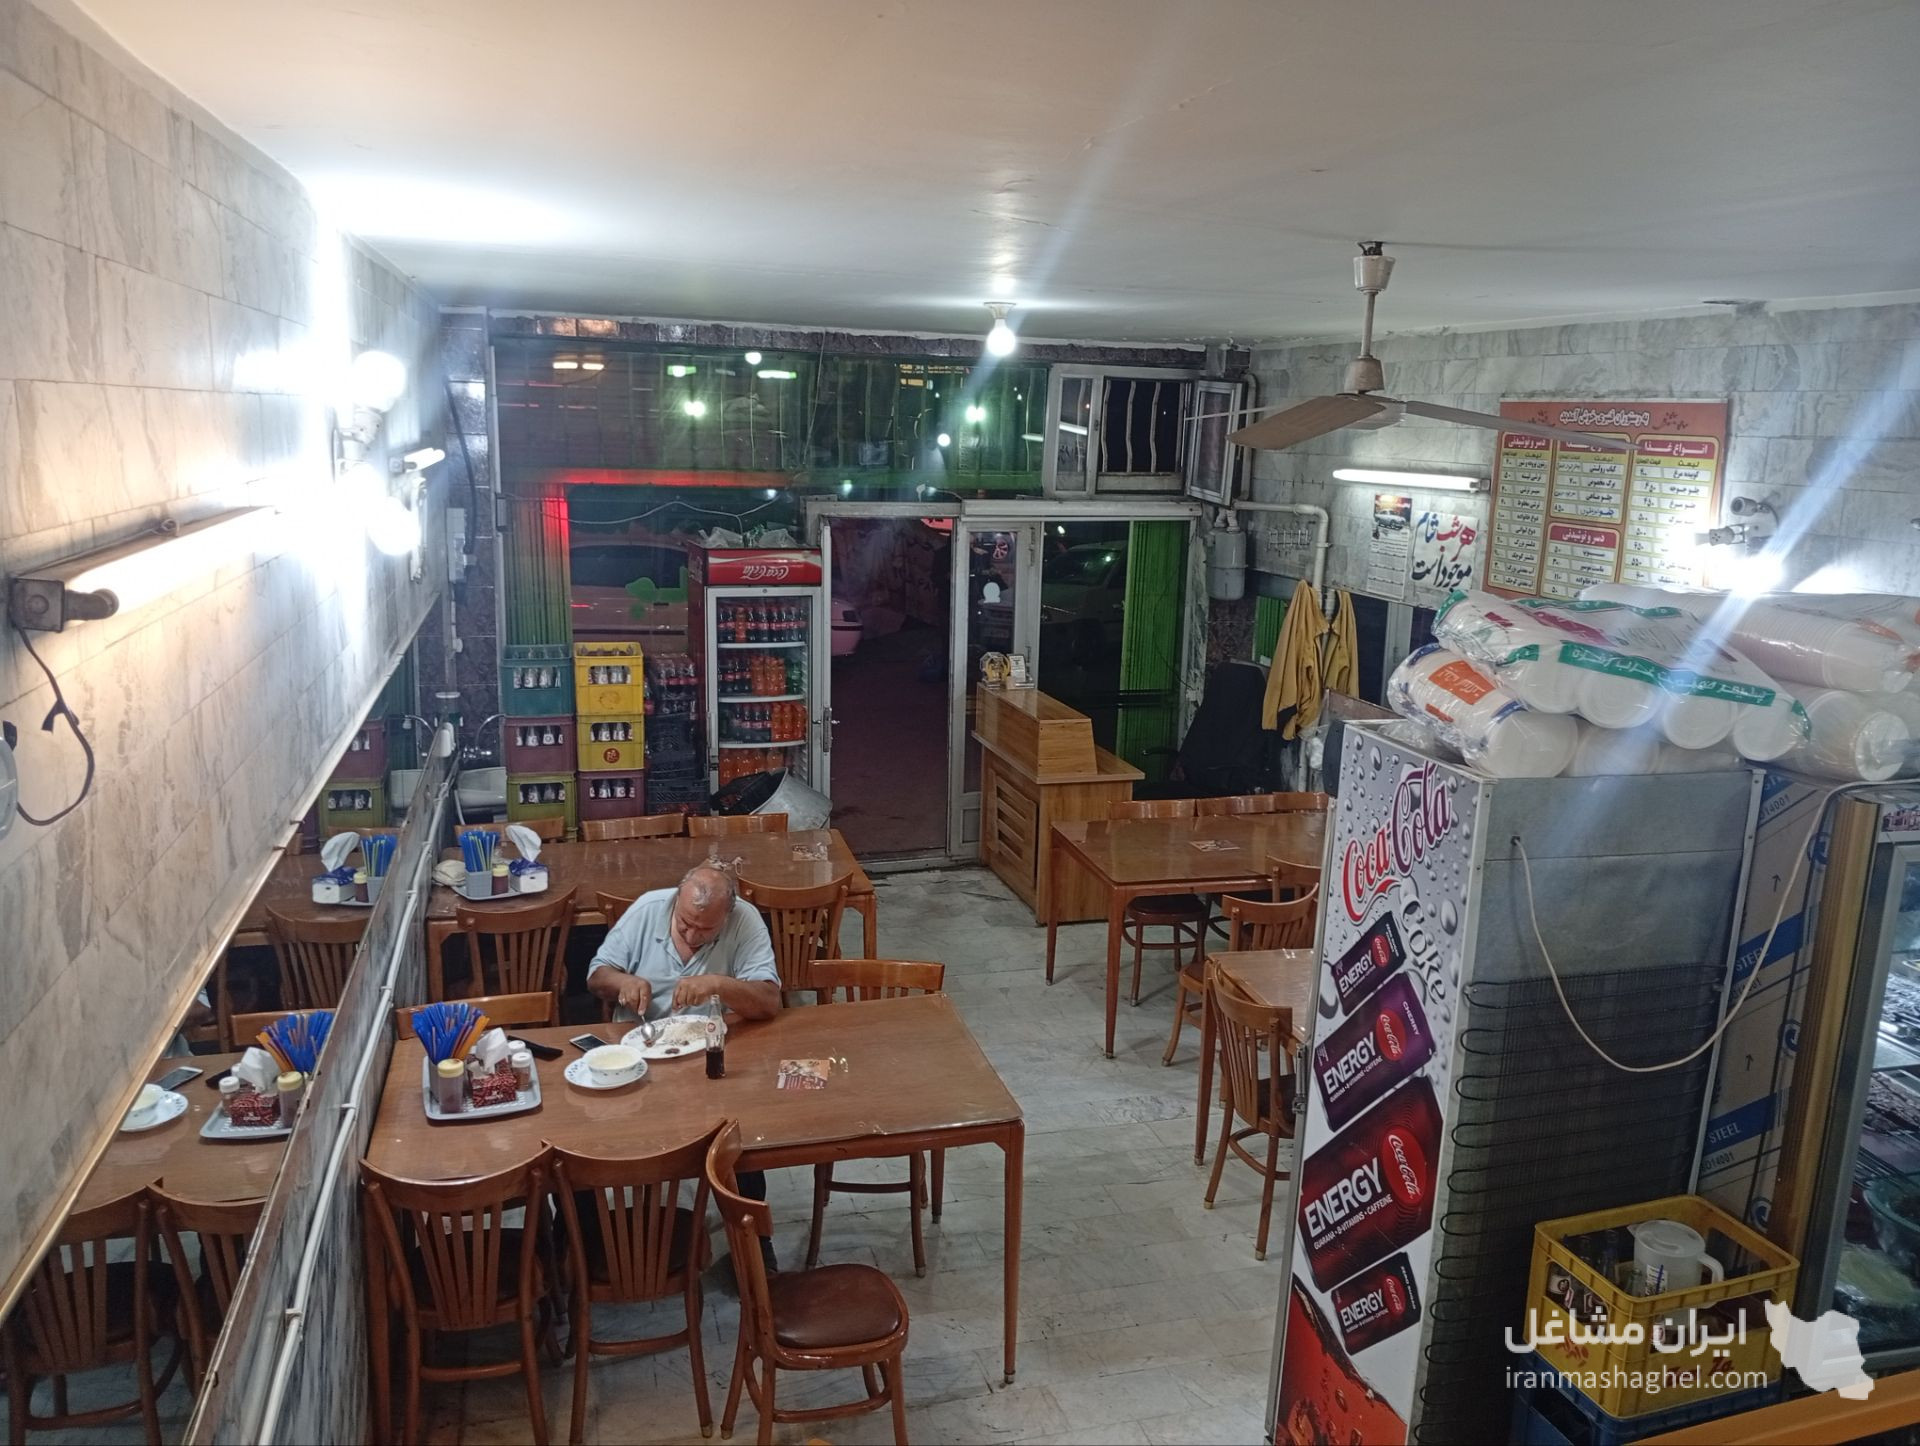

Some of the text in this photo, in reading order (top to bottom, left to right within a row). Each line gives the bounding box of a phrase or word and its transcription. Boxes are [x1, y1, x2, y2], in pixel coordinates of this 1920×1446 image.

[1508, 435, 1531, 448] نوشیدنی
[1644, 441, 1708, 456] انواع غذا
[1416, 512, 1477, 562] هر شب شام
[1562, 528, 1587, 543] نوشیدنی
[1592, 534, 1606, 545] دسر
[1411, 554, 1444, 585] است
[1440, 563, 1472, 593] موجود
[1341, 759, 1453, 925] Coca-Cola
[1400, 893, 1449, 1006] Coke
[1339, 949, 1375, 993] ENERGY
[1402, 1001, 1420, 1036] CHERRY
[1322, 1031, 1377, 1095] ENERGY
[1708, 1122, 1742, 1145] STEEL
[1388, 1133, 1421, 1200] Coca-Cola
[1304, 1157, 1384, 1238] ENERGY
[1367, 1196, 1393, 1214] CAFFEINE
[1341, 1288, 1385, 1328] ENERGY
